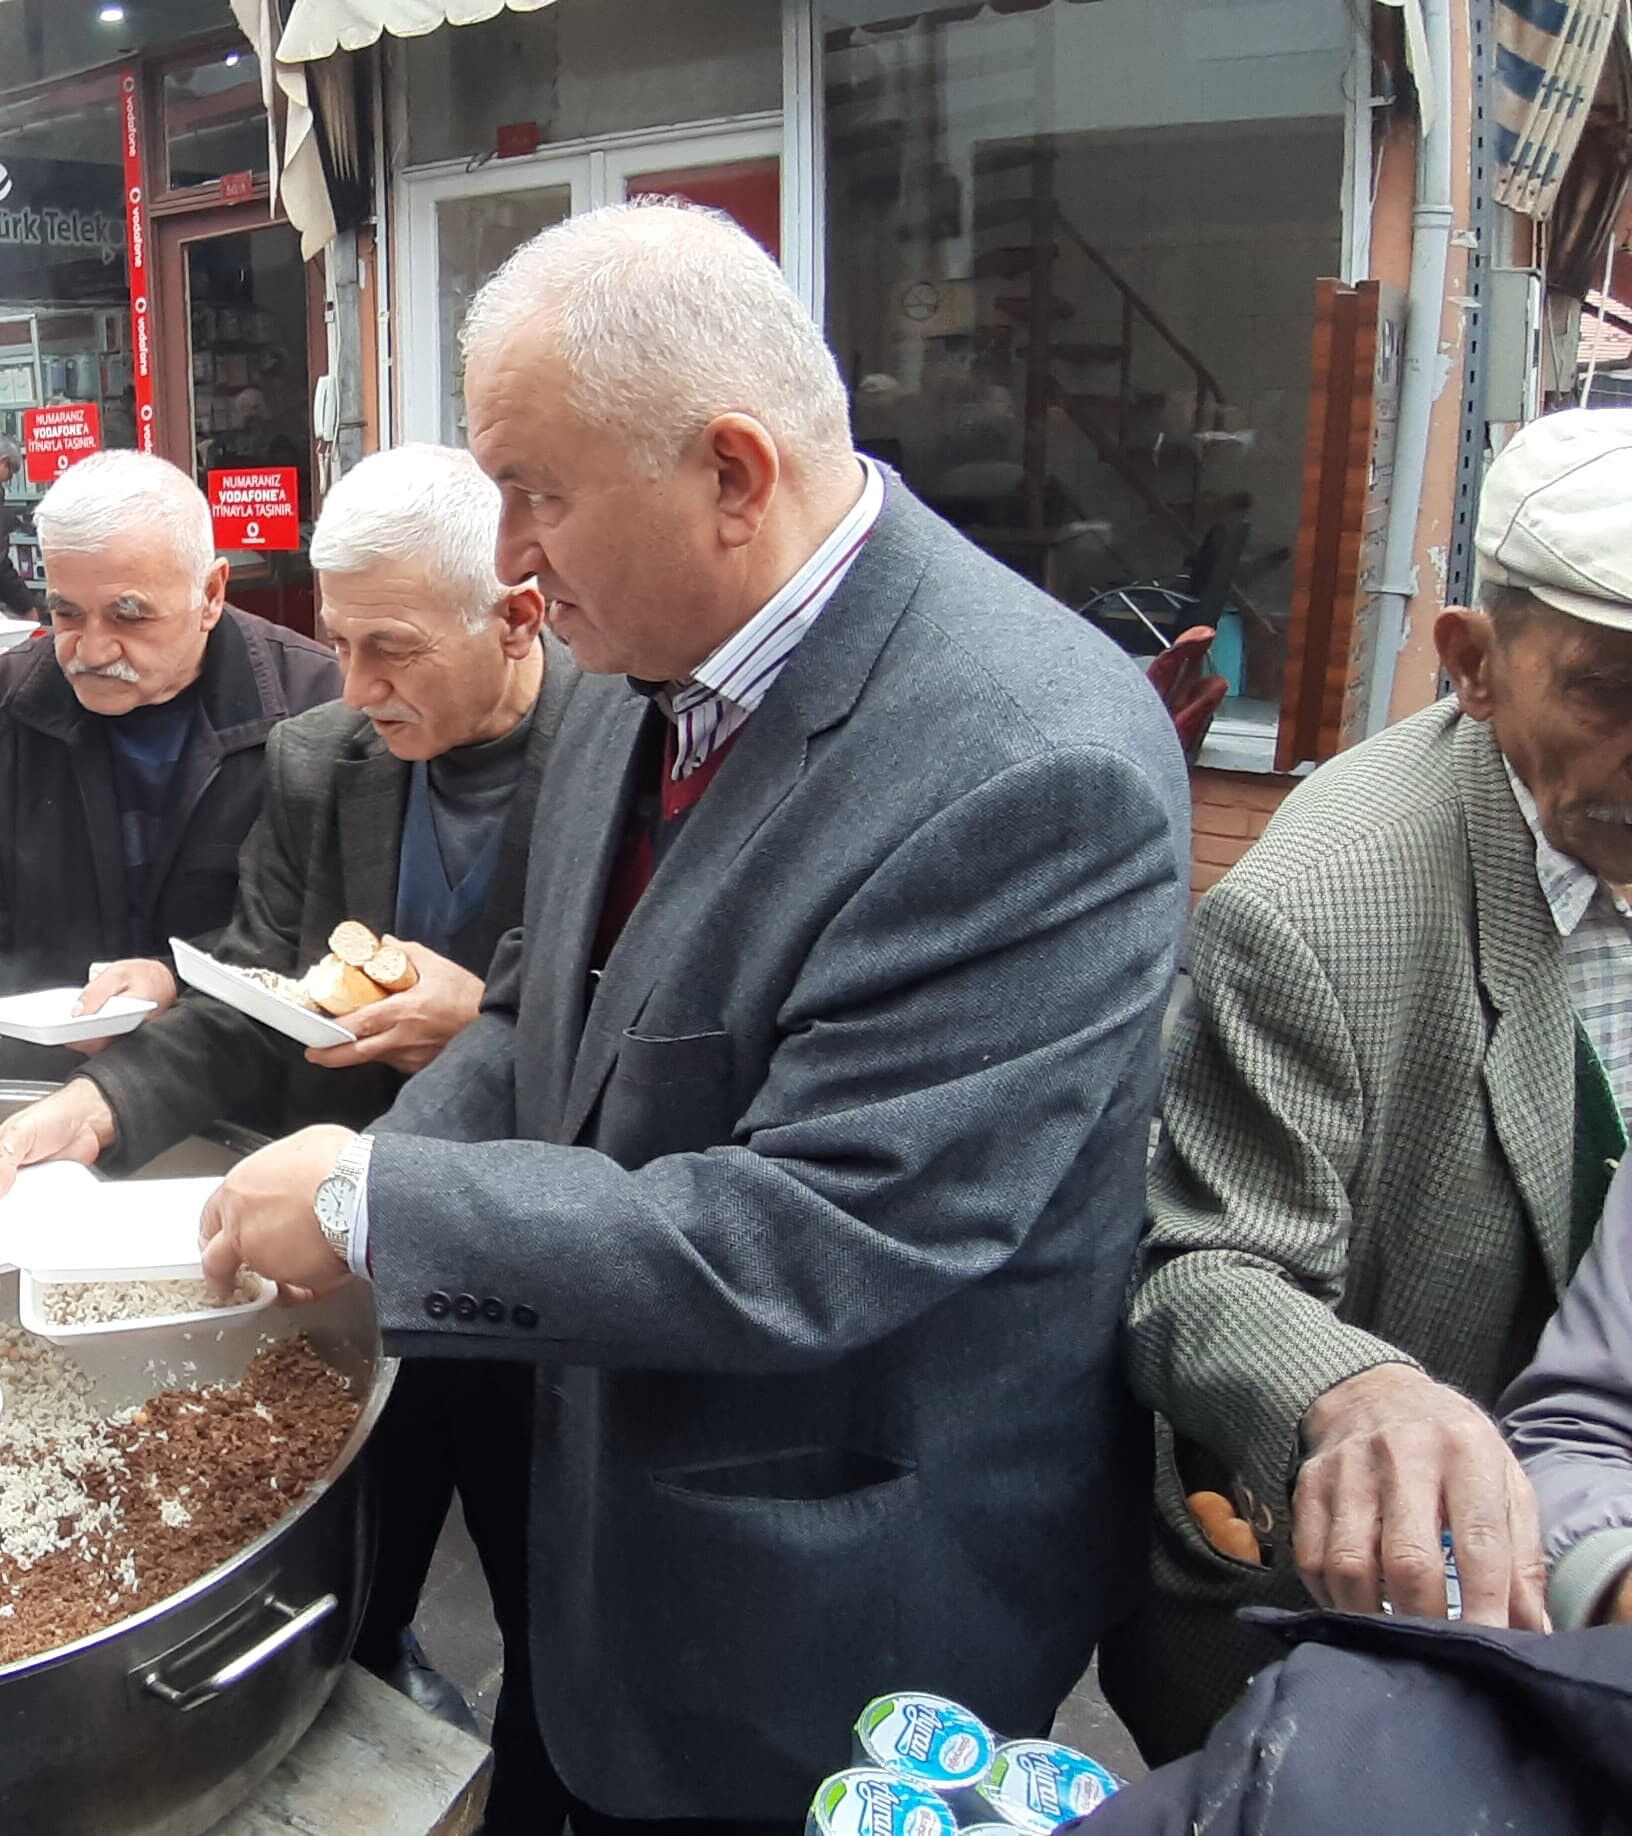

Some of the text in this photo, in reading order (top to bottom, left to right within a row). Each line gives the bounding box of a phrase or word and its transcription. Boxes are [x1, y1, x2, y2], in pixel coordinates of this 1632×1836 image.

[125, 96, 136, 157] vodafone
[131, 206, 143, 268] vodafone
[137, 317, 148, 377] vodafone
[222, 474, 281, 489] NUMARANIZ
[895, 1703, 944, 1763] Ayran
[855, 1780, 902, 1836] Ayra
[1017, 1751, 1063, 1818] Ayran
